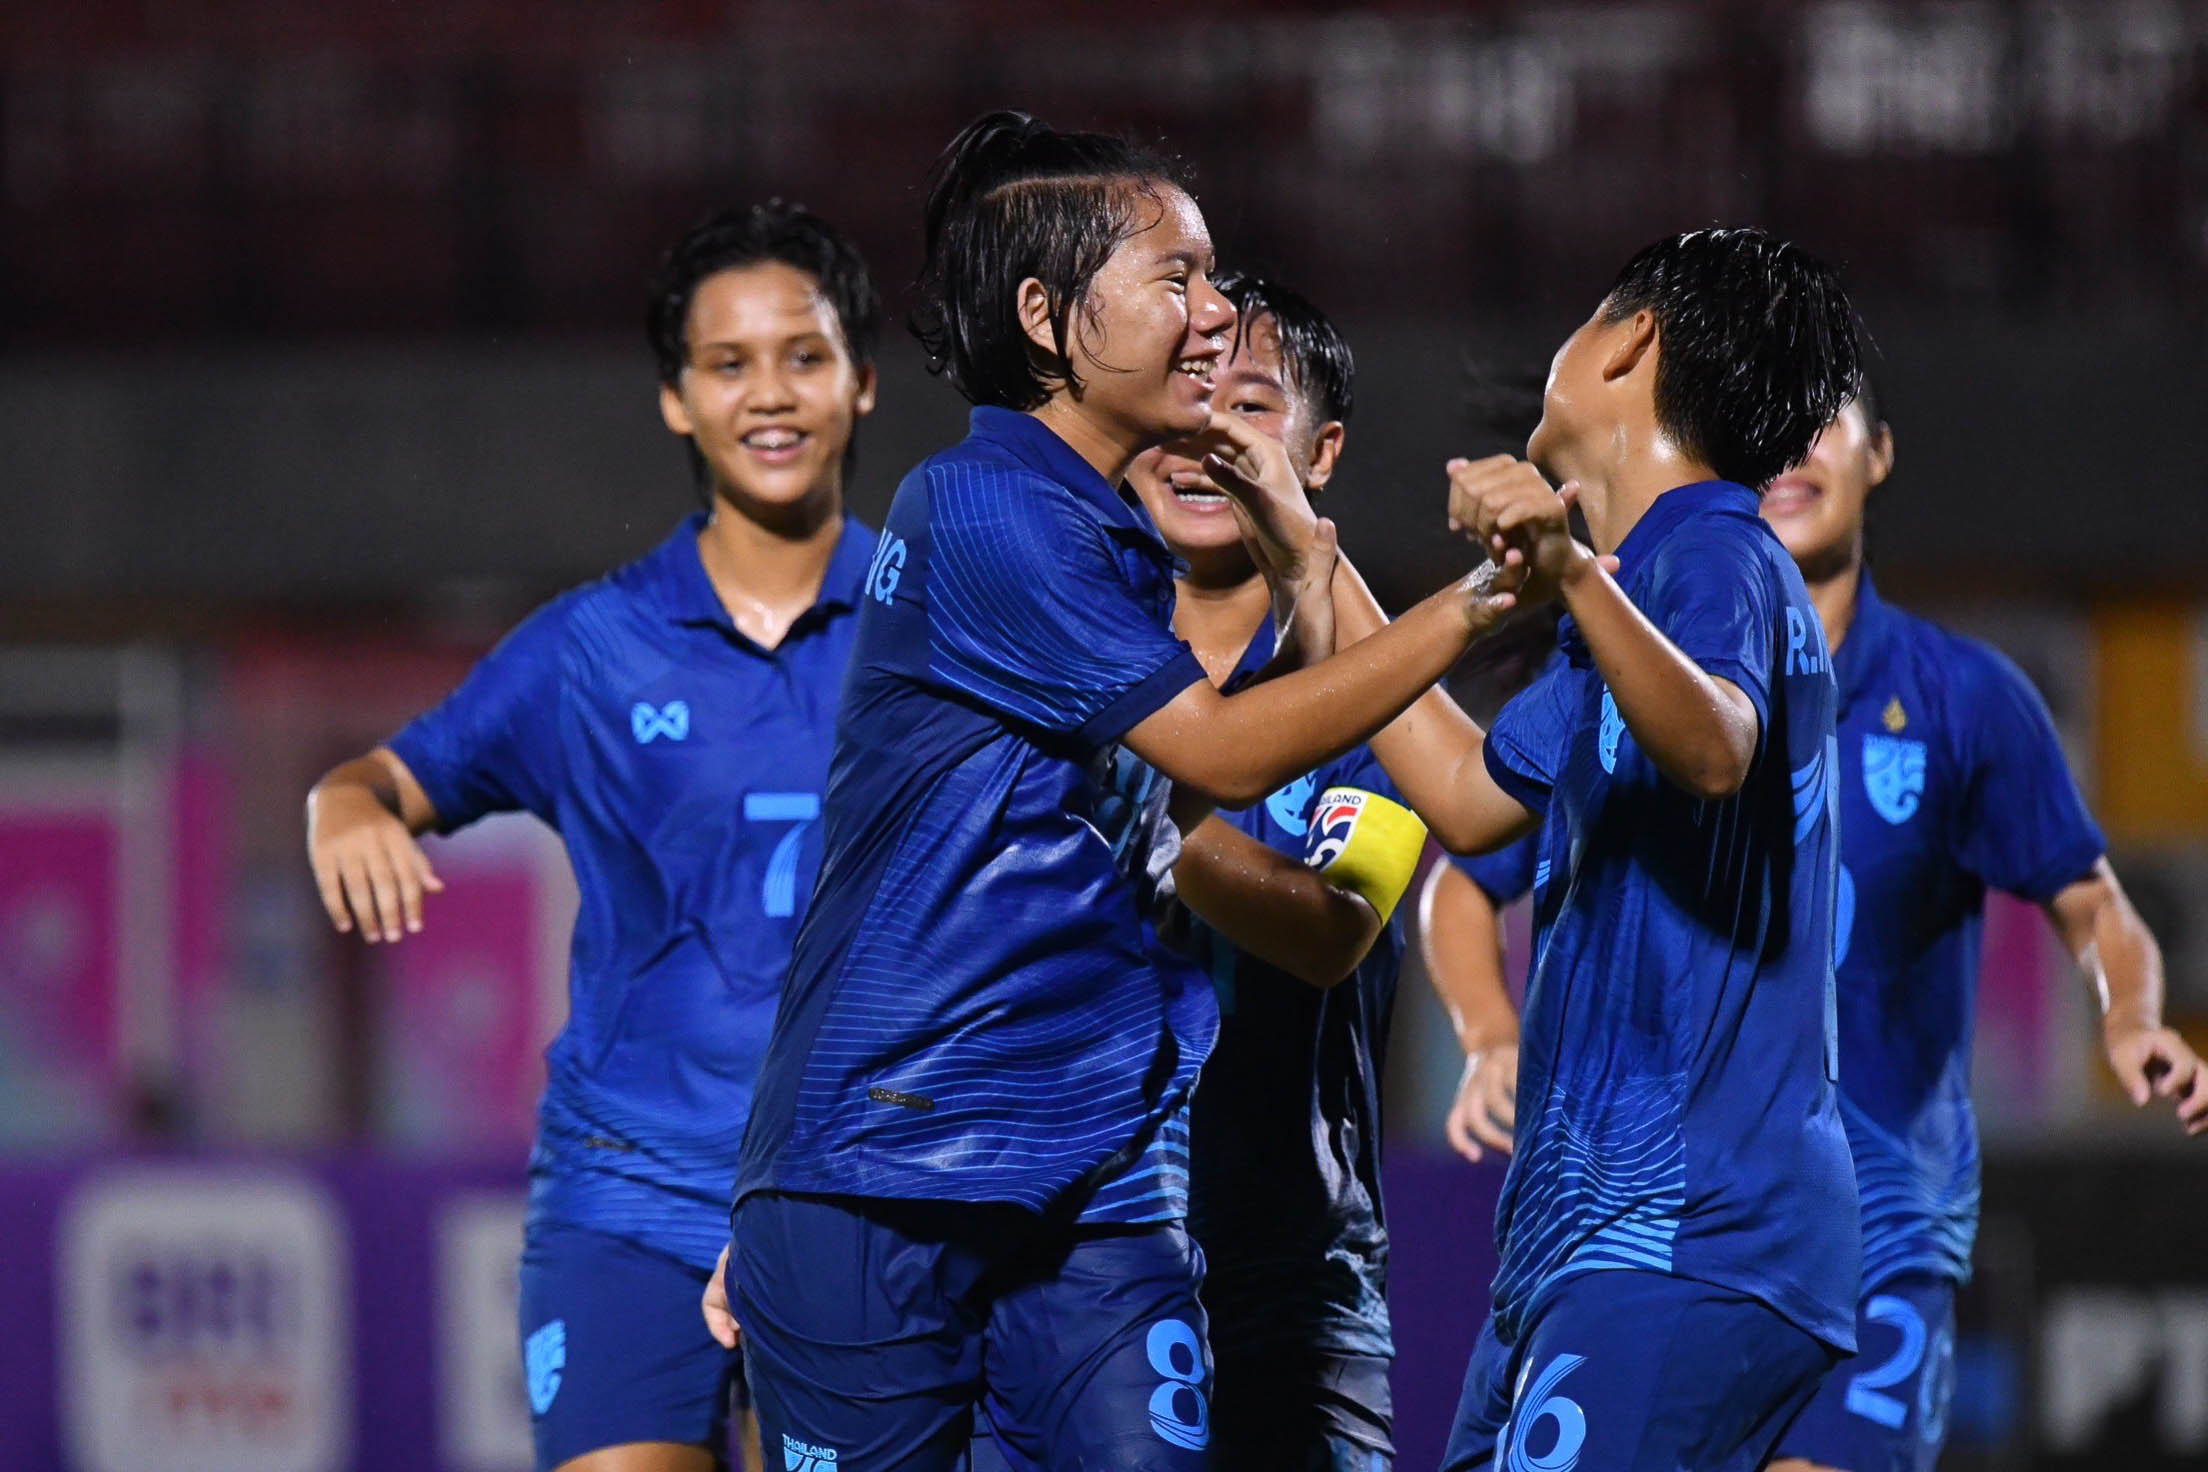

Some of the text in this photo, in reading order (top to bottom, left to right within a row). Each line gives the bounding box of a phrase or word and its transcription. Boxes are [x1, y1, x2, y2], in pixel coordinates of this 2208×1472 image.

[744, 793, 820, 917] 7
[782, 1433, 837, 1460] THAILAND
[1147, 1319, 1209, 1450] 8
